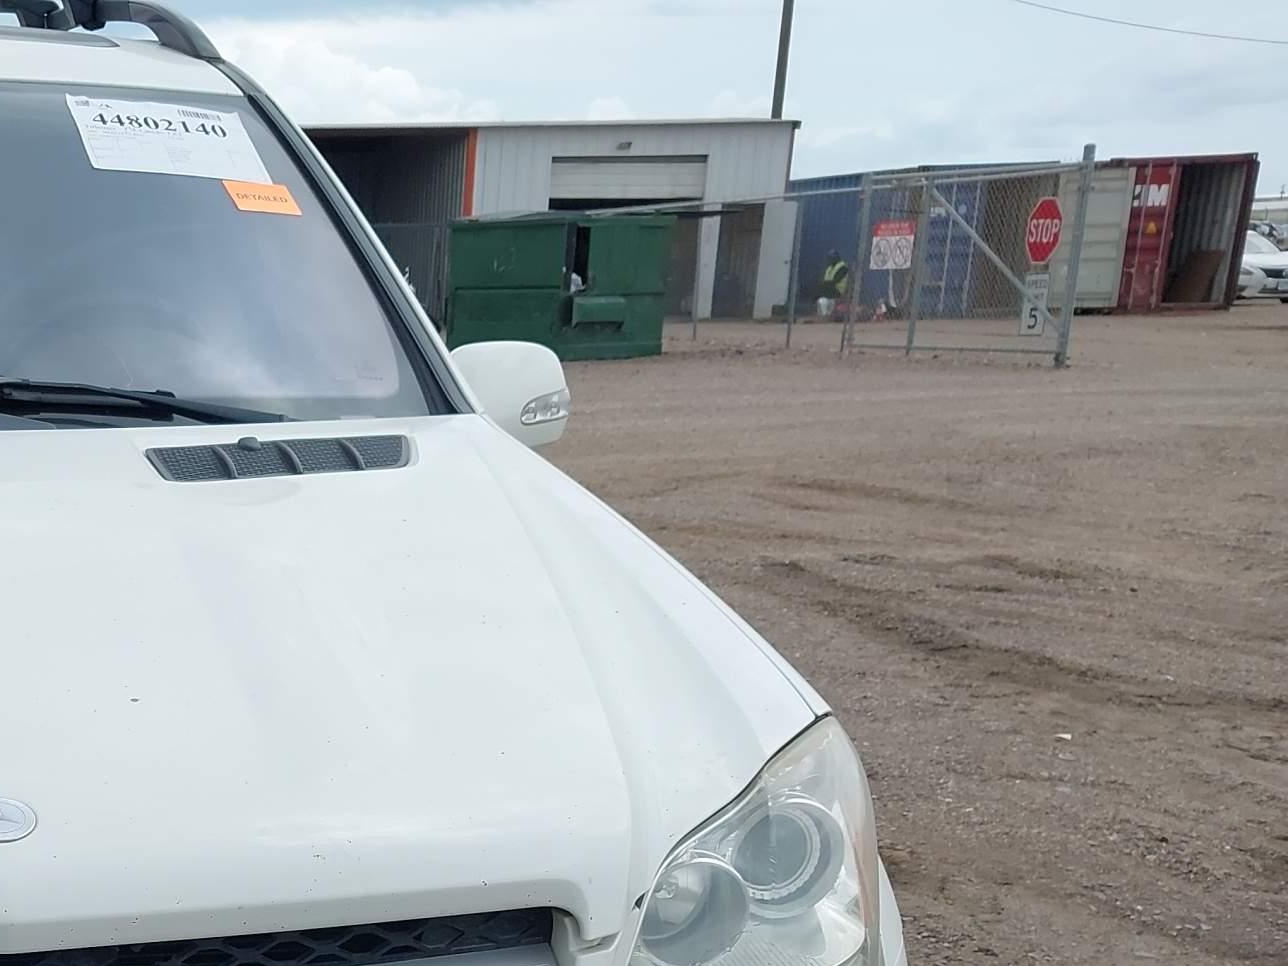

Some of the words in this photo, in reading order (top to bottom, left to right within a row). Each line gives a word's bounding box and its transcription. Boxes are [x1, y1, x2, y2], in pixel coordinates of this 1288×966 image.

[92, 113, 227, 138] 44802140
[235, 192, 289, 204] DETAILED
[1029, 218, 1060, 242] STOP
[1026, 307, 1039, 330] 5
